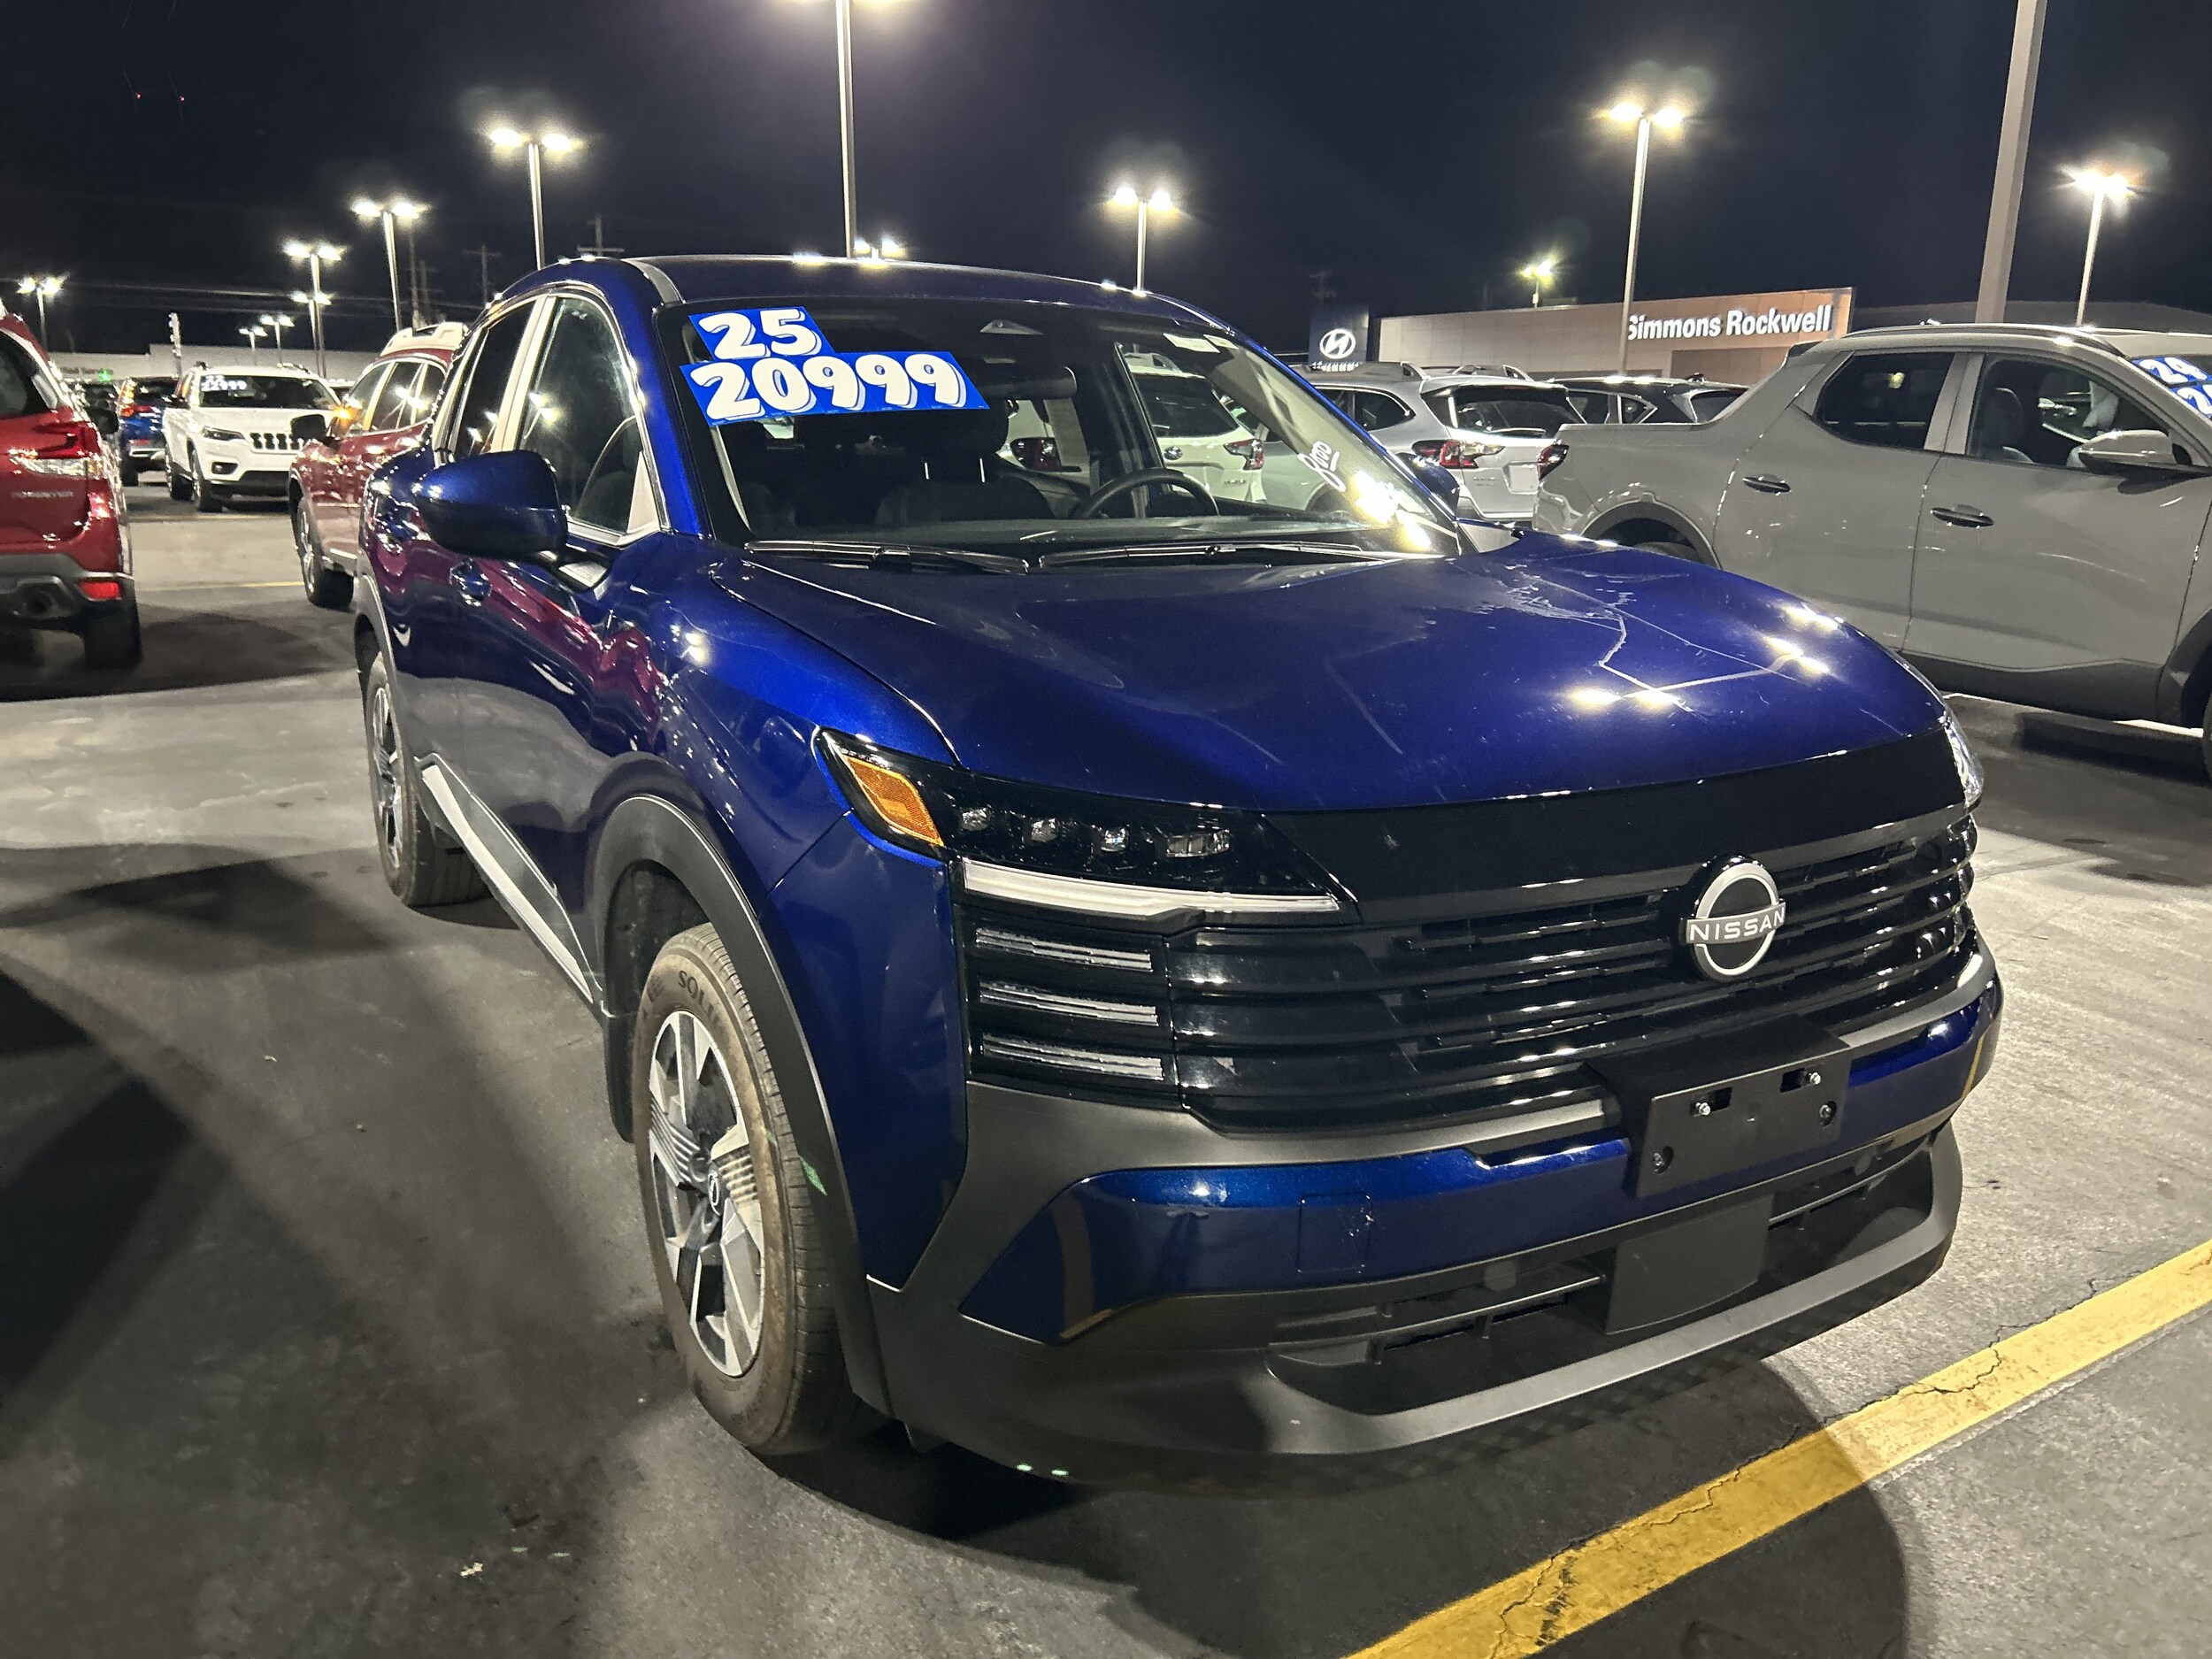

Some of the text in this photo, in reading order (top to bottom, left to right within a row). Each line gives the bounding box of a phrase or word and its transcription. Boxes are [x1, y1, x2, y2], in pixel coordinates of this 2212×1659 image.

[697, 308, 822, 361] 25
[1627, 304, 1832, 341] Simmons Rockwell
[690, 353, 967, 421] 20999
[1689, 906, 1785, 941] NISSAN
